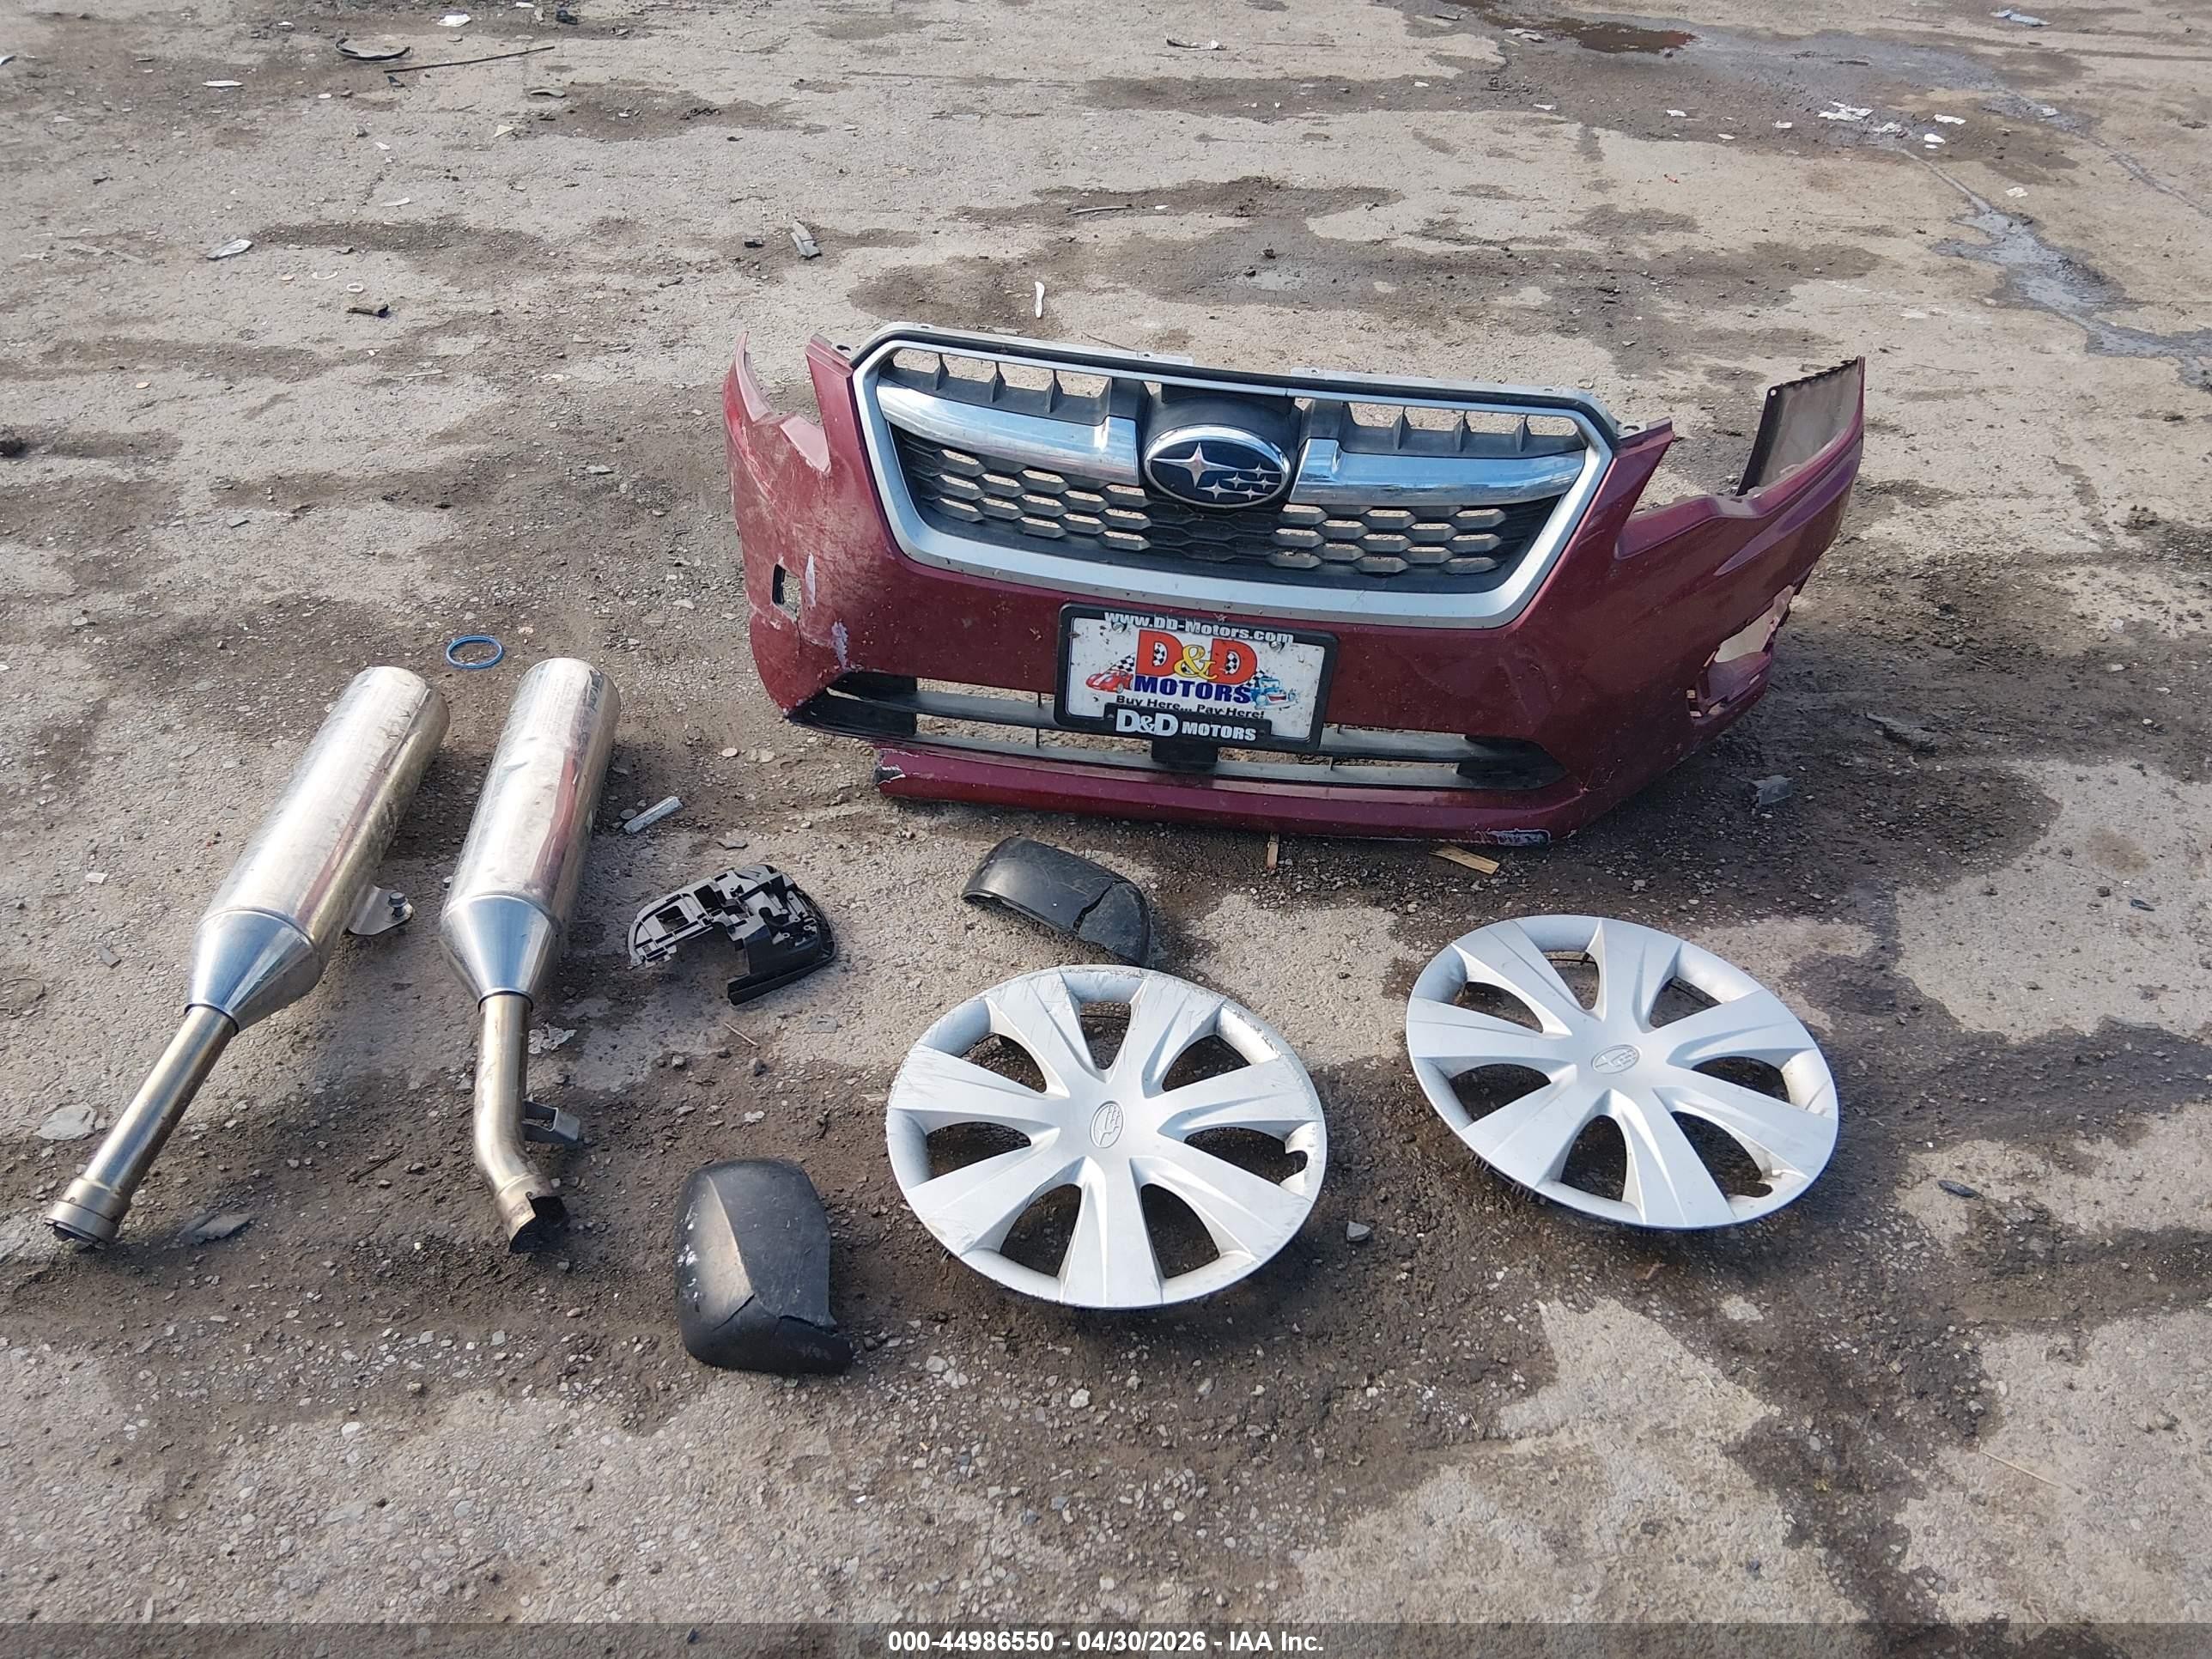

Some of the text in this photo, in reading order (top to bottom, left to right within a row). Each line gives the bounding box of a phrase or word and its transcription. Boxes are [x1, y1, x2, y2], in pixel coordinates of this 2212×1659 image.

[1135, 629, 1258, 685] D&D
[1134, 676, 1251, 704] MOTORS
[1116, 695, 1143, 708] Buy
[1197, 704, 1224, 716] Pay
[1225, 707, 1265, 720] Here!
[1116, 708, 1257, 741] D&D MOTORS
